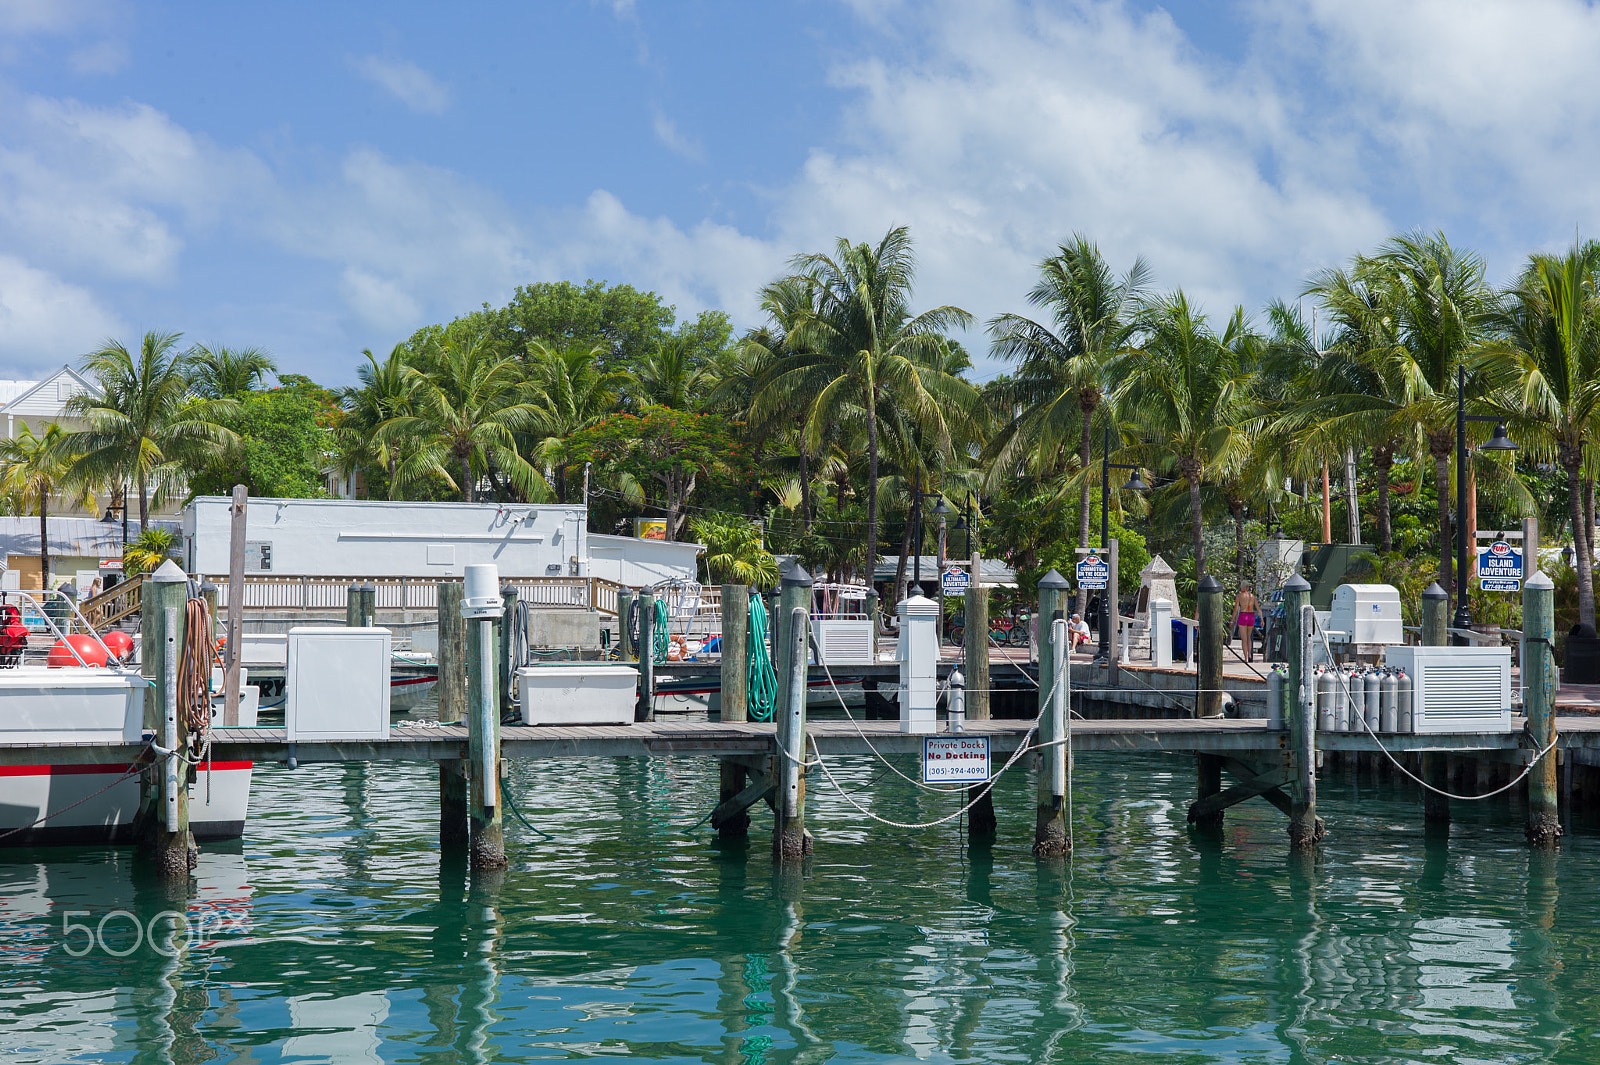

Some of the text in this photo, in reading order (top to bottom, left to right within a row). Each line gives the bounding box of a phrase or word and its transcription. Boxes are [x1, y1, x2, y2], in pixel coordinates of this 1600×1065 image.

[1488, 559, 1514, 568] ISLAND
[1480, 567, 1521, 576] ADVENTURE
[928, 740, 985, 749] Private Docks
[928, 751, 986, 761] No Docking
[928, 767, 985, 775] (305)-294-4090
